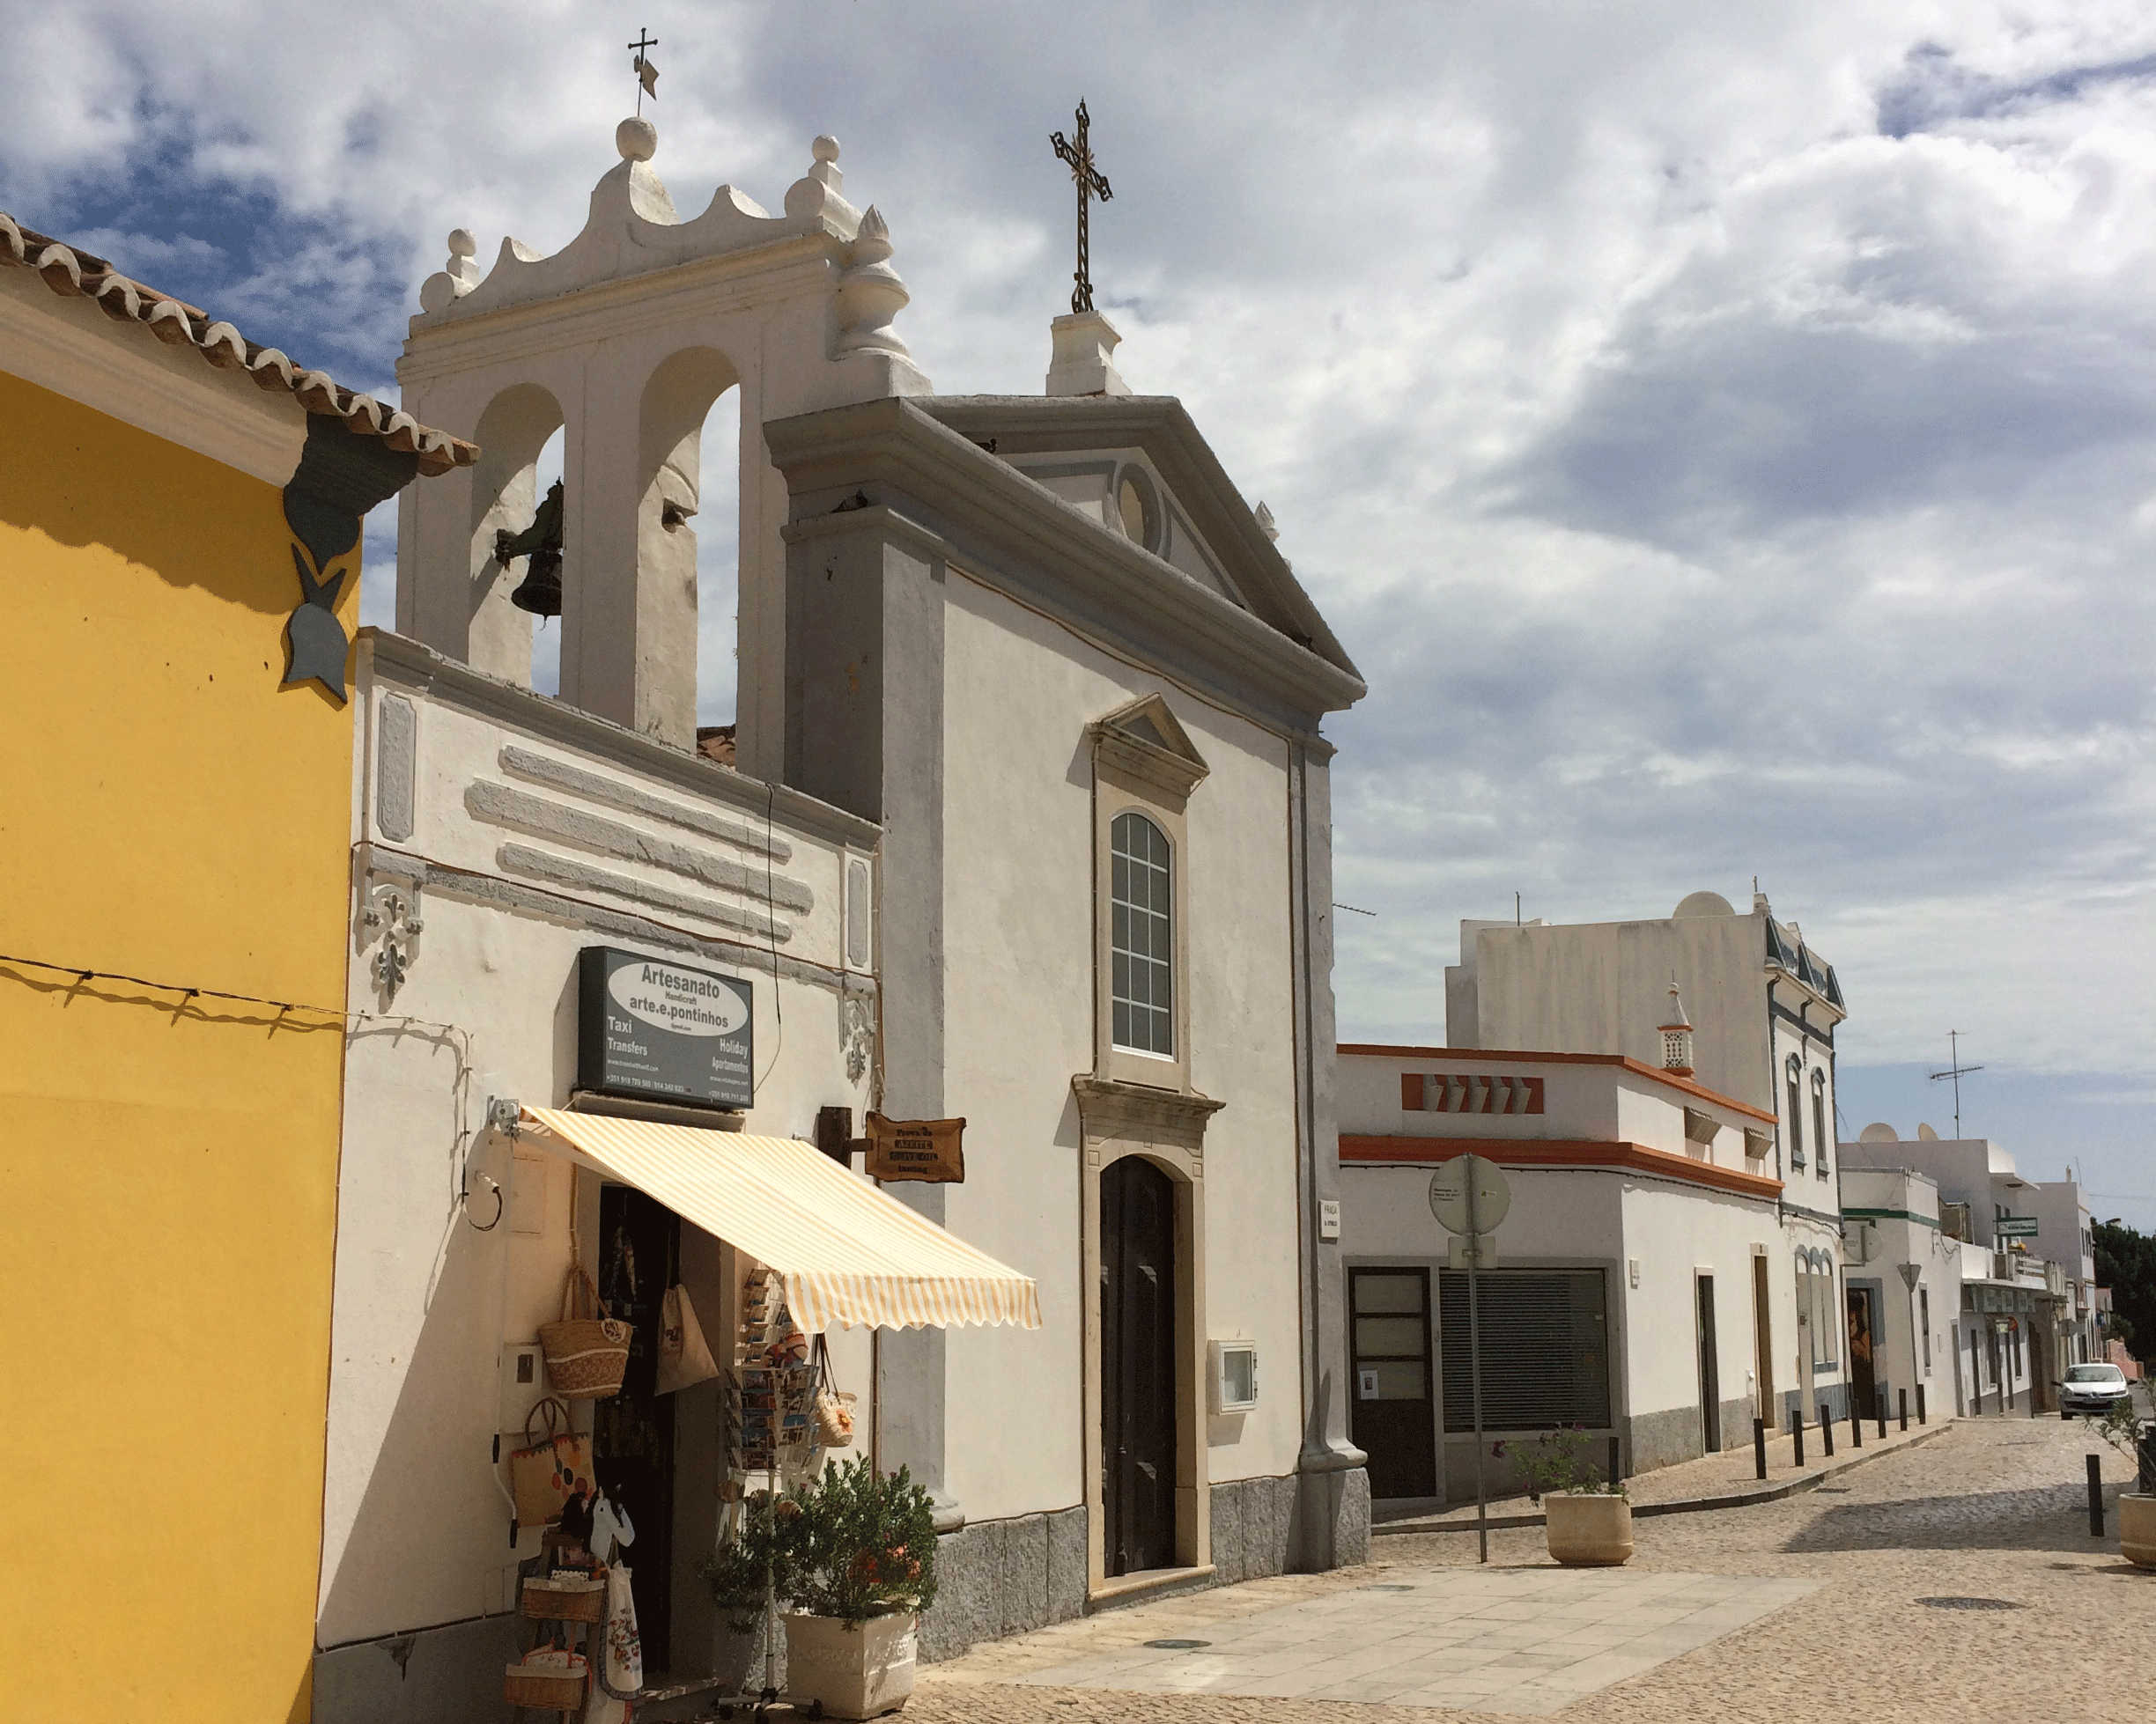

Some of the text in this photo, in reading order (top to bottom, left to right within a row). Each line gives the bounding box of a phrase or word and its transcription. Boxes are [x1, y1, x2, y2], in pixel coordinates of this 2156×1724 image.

[641, 964, 720, 998] Artesanato
[665, 991, 698, 1006] Handicraft
[630, 997, 729, 1028] arte.e.pontinhos
[608, 1016, 632, 1034] Taxi
[608, 1036, 648, 1057] Transfers
[720, 1037, 749, 1059] Holiday
[897, 1140, 932, 1149] AZEITE
